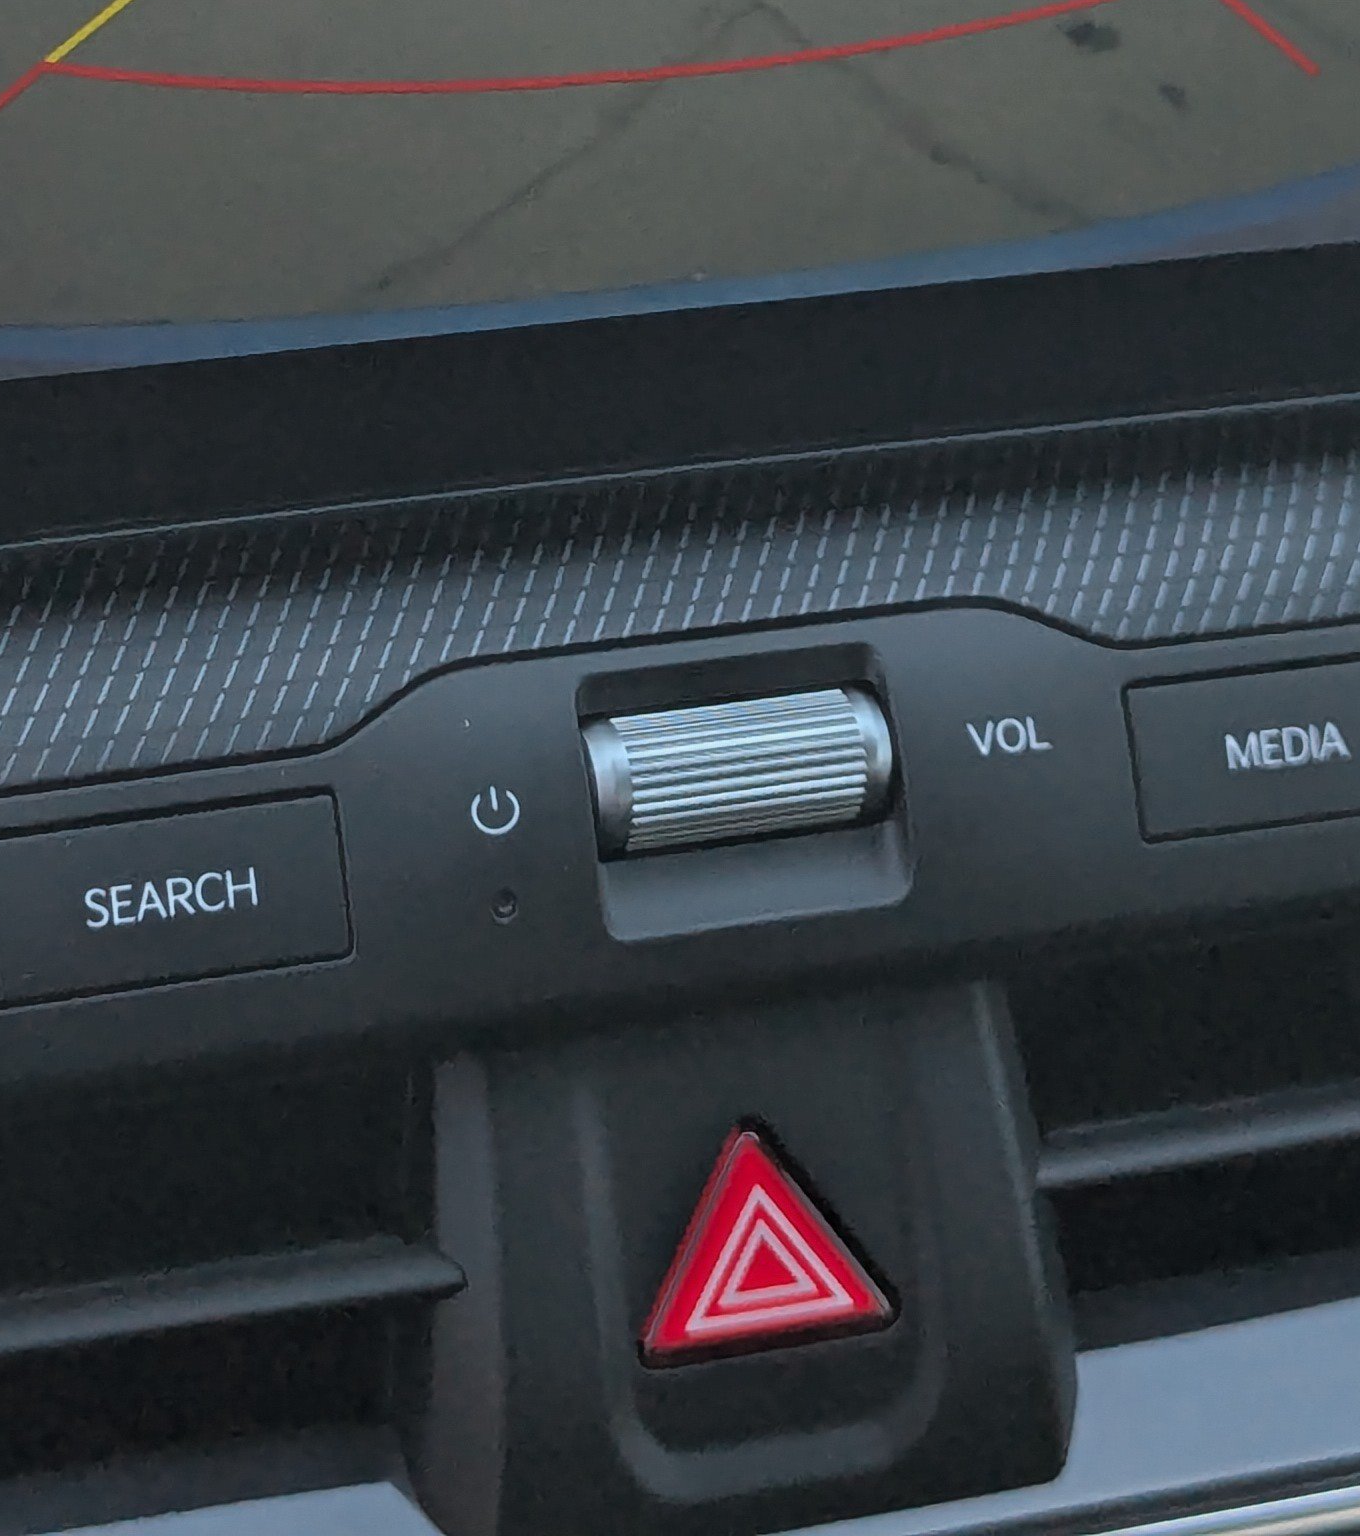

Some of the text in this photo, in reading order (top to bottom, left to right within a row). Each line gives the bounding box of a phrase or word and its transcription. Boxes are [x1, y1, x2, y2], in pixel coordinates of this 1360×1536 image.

[965, 716, 1054, 759] VOL
[1225, 721, 1353, 772] MEDIA
[83, 866, 260, 931] SEARCH
